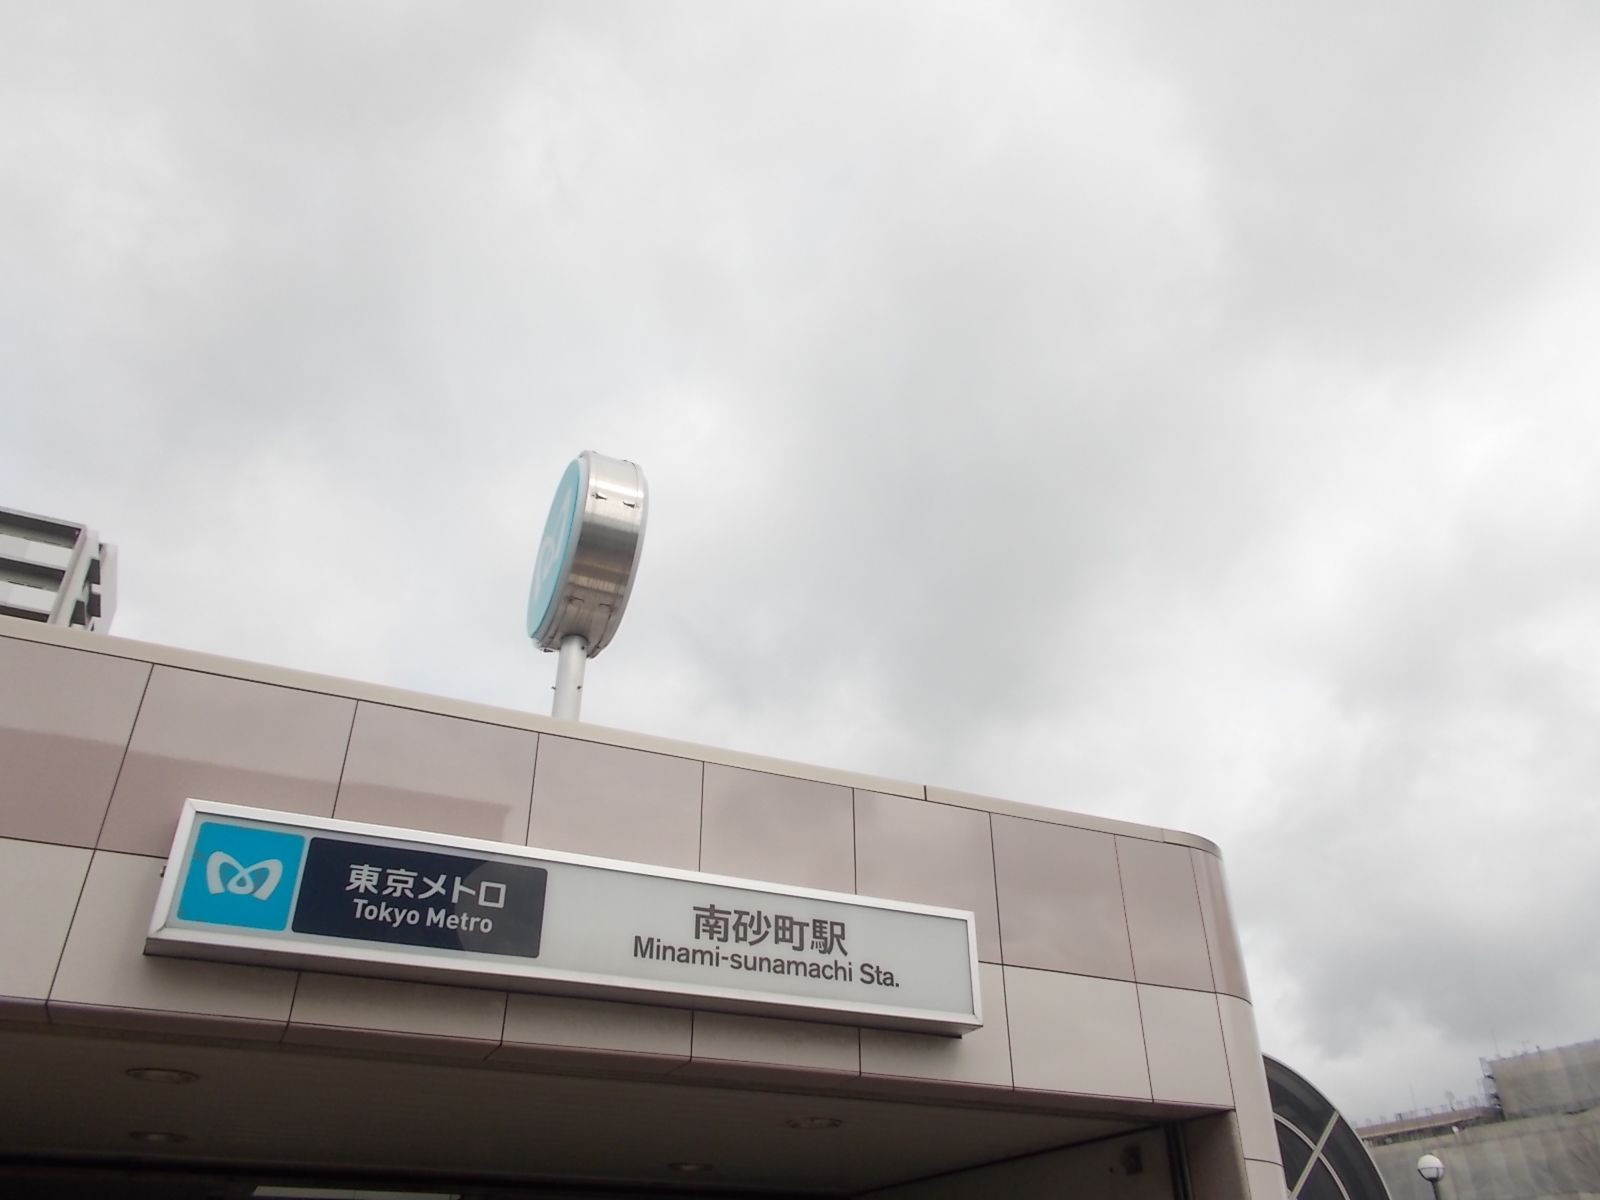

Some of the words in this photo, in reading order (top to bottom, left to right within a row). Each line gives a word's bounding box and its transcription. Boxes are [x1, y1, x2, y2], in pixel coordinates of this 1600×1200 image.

[345, 863, 507, 909] 東京メトロ
[353, 899, 420, 927] Tokyo
[426, 907, 493, 933] Metro
[692, 903, 849, 956] 南砂町駅
[633, 935, 853, 983] Minami-sunamachi
[859, 963, 900, 988] Sta.
